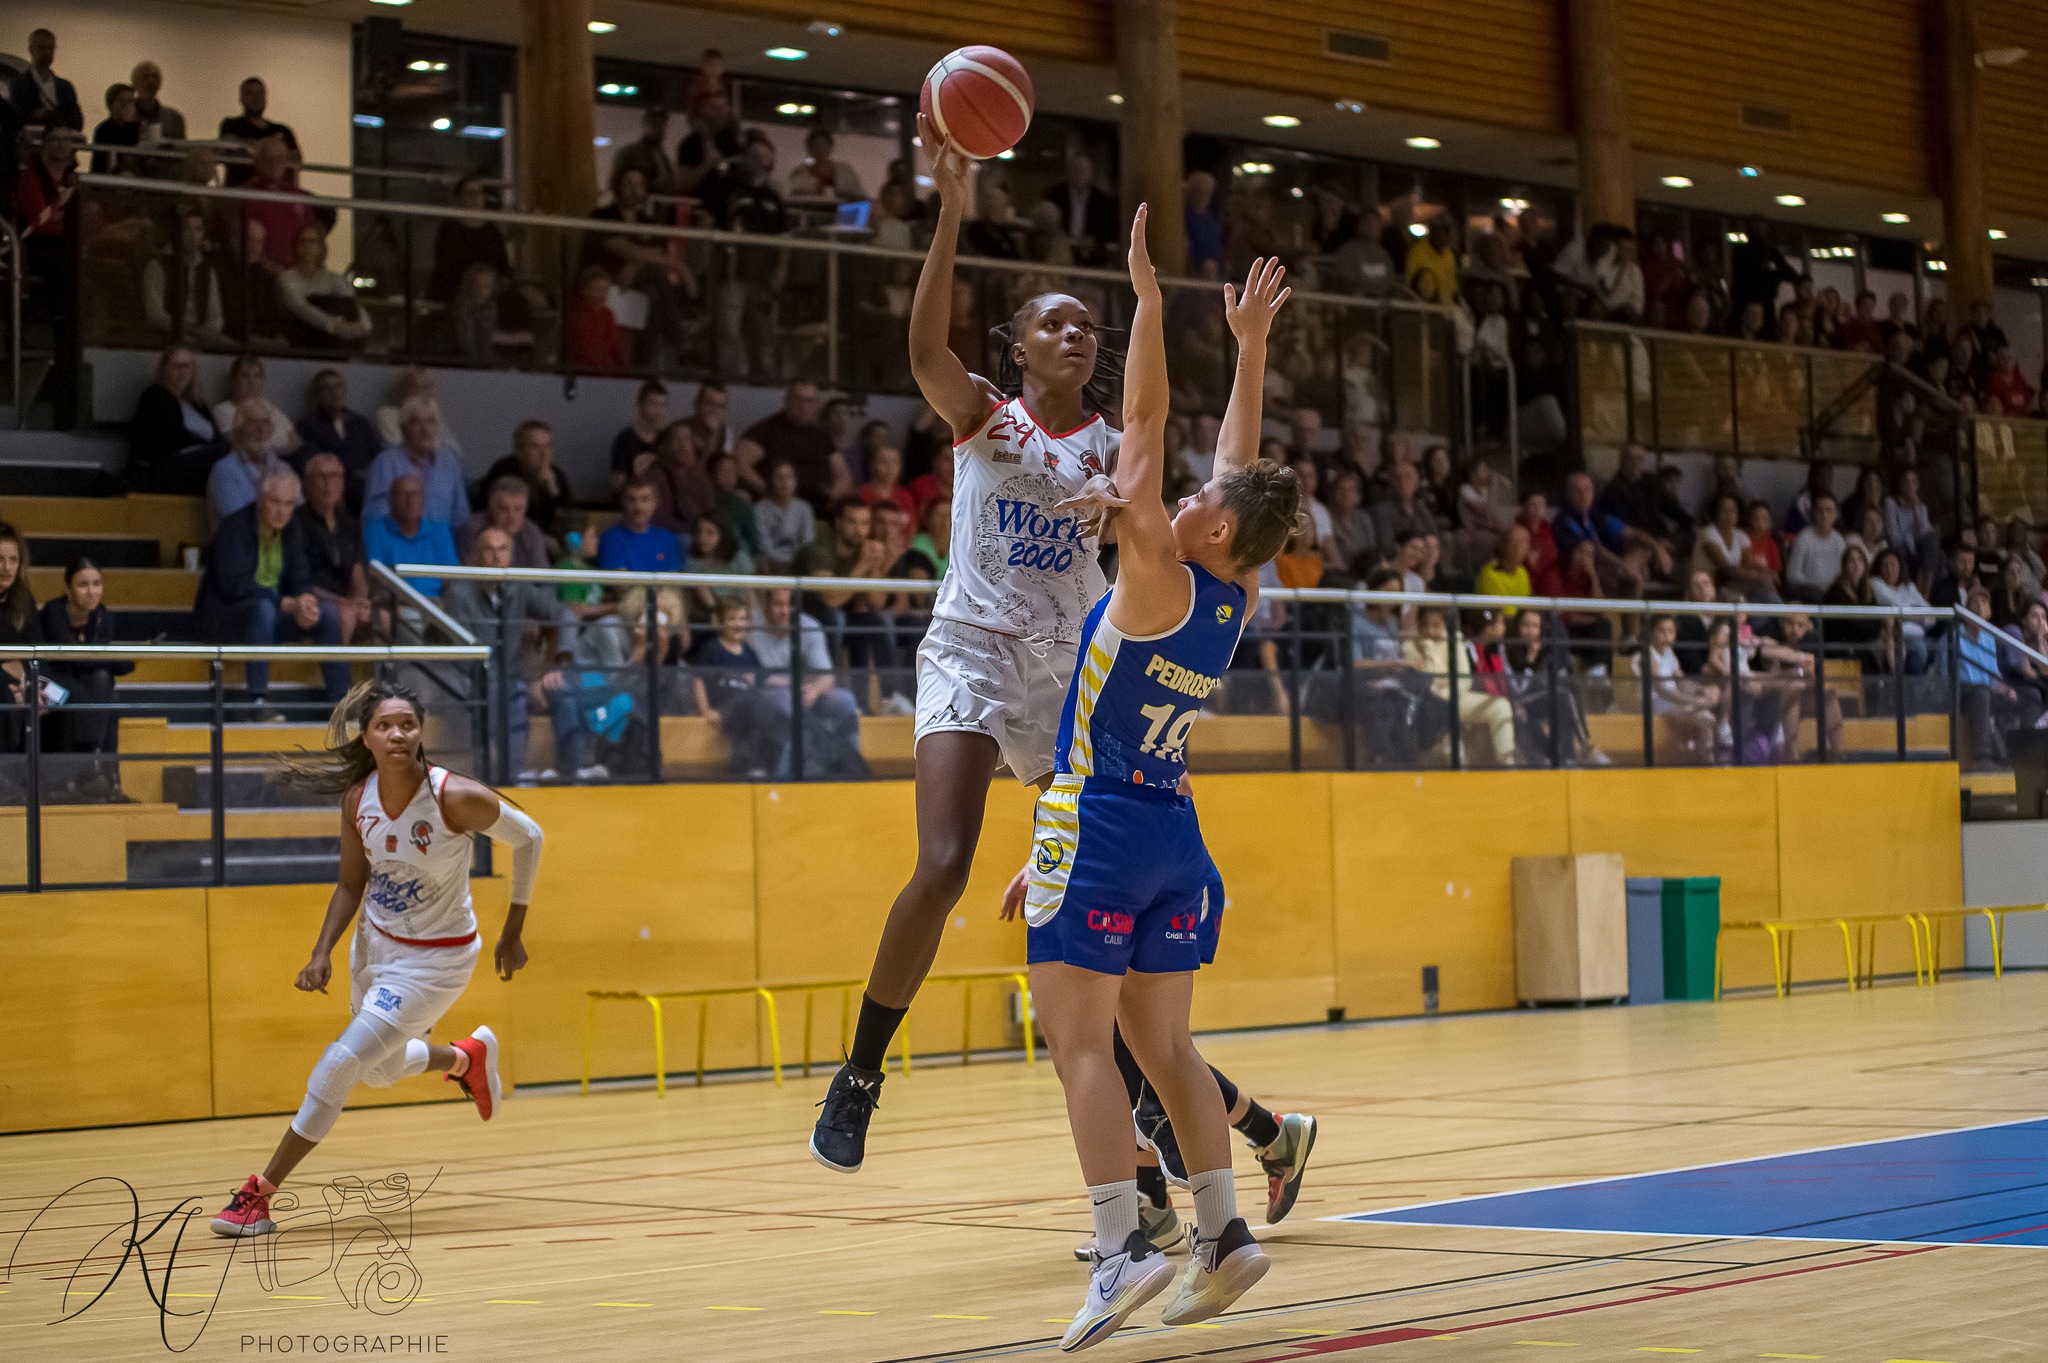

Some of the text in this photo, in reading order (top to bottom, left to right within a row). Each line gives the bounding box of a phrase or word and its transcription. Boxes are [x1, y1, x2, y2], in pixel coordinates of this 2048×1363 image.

[987, 413, 1037, 449] 24
[1007, 541, 1073, 573] 2000
[1144, 653, 1221, 699] PEDROS
